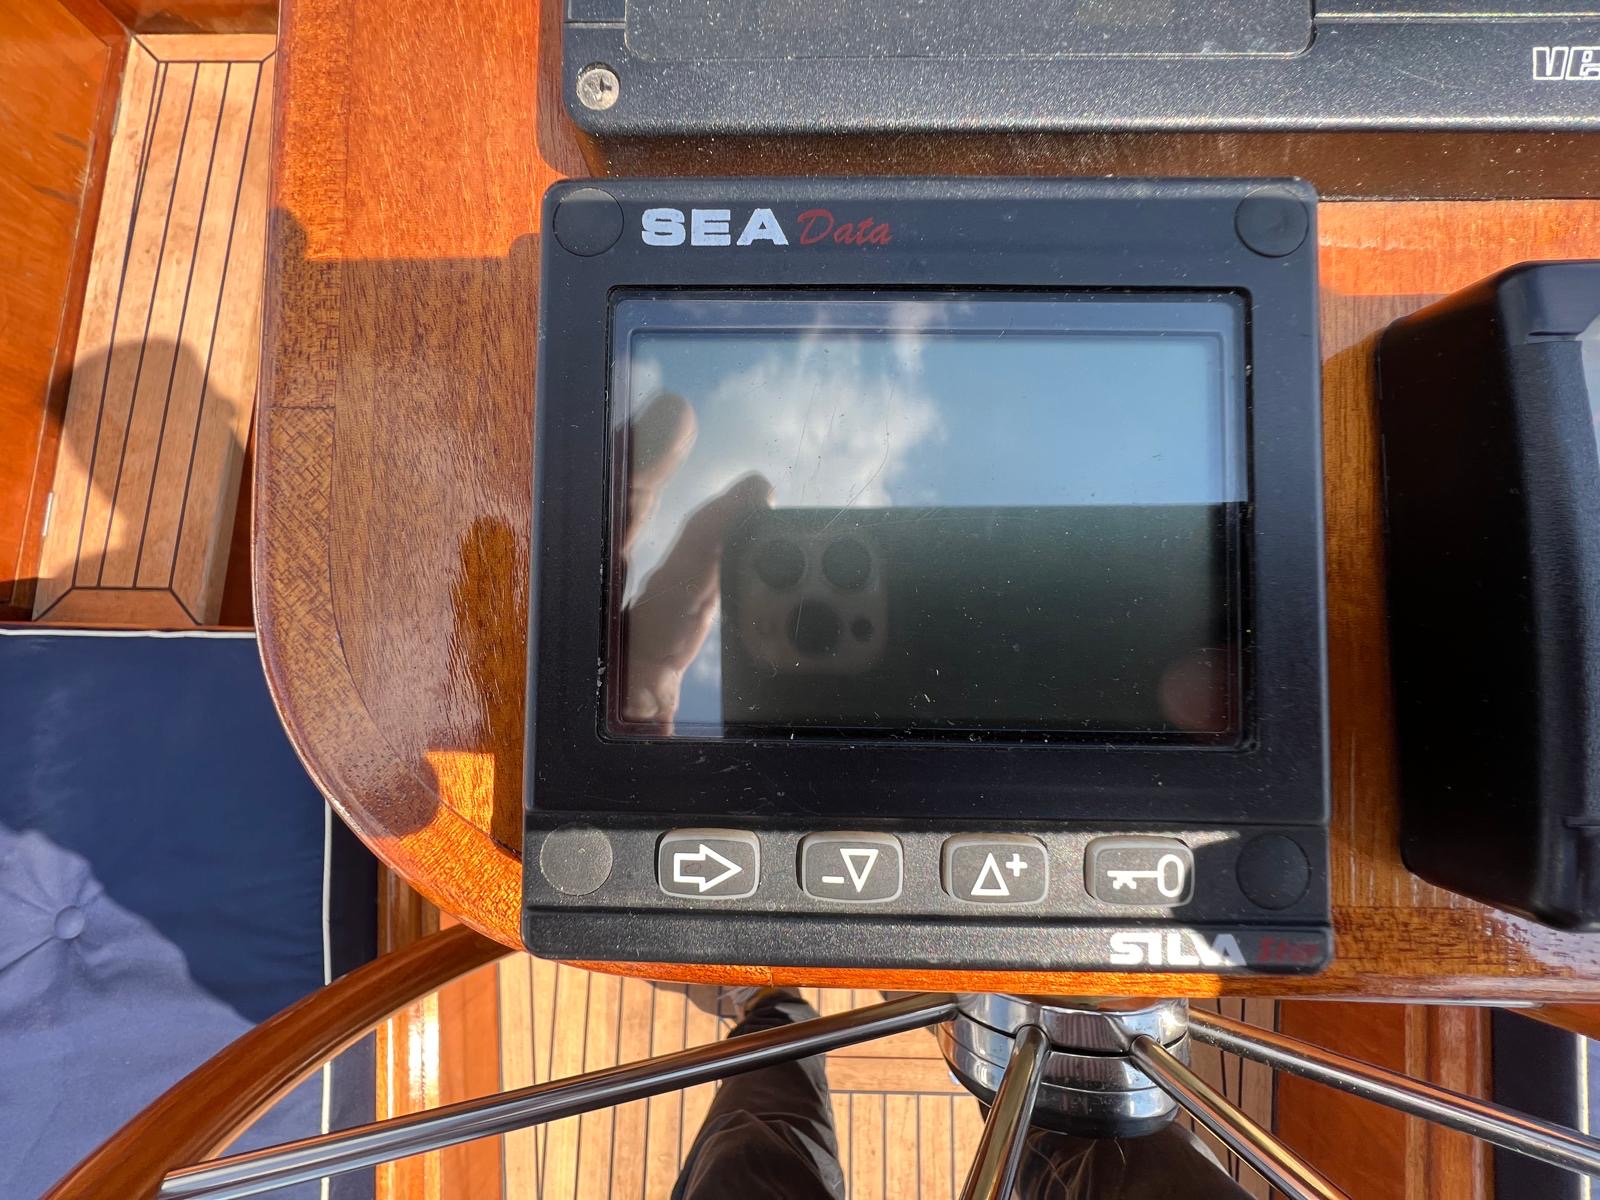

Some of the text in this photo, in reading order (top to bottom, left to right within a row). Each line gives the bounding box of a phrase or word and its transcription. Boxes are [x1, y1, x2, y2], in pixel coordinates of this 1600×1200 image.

[641, 207, 893, 246] SEA Data
[1109, 932, 1247, 967] SILVA
